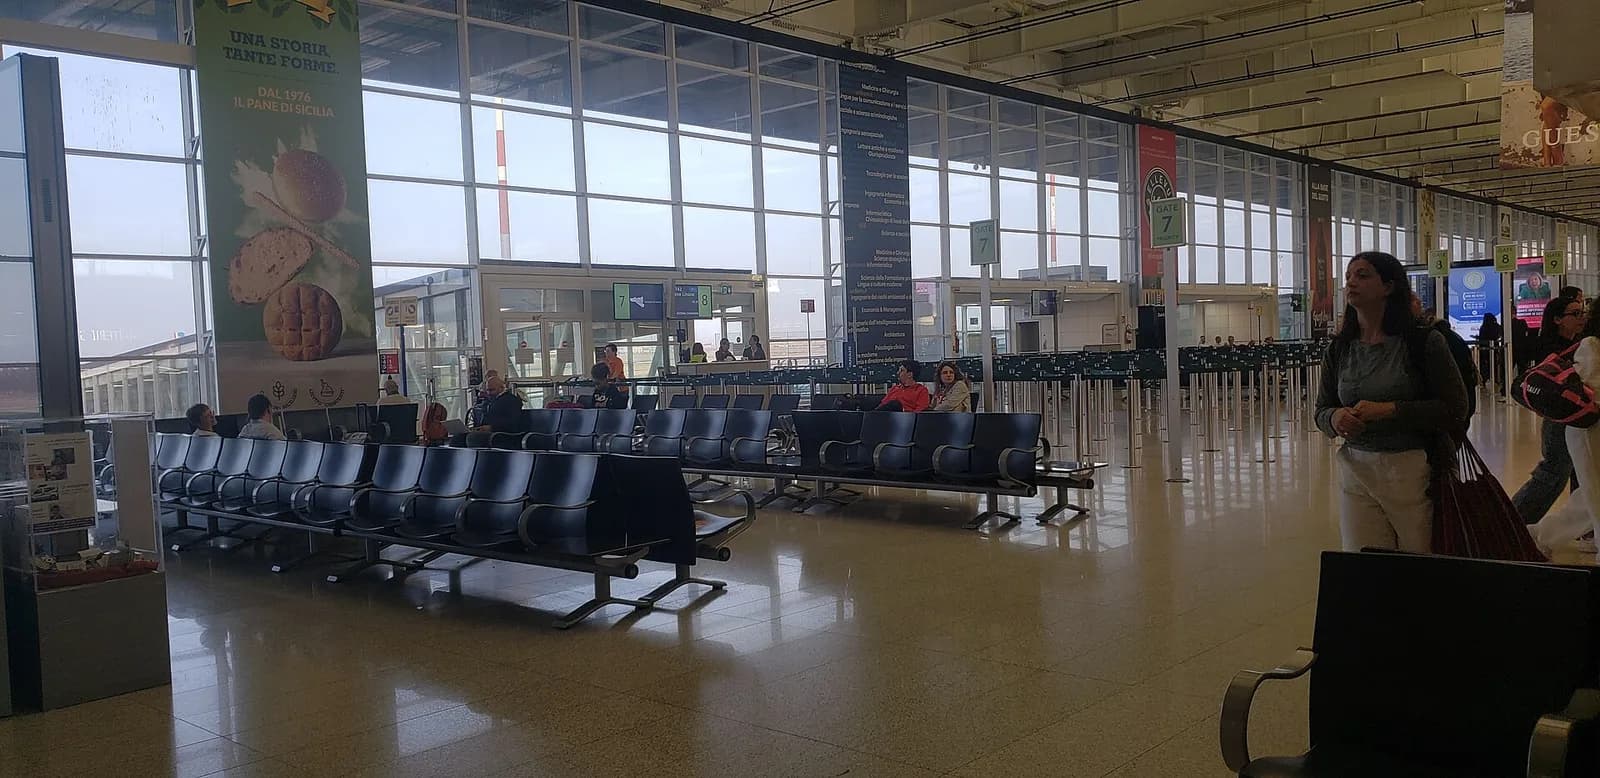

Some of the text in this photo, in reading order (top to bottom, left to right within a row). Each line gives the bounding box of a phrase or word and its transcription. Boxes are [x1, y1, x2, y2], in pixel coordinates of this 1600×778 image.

[229, 30, 266, 47] UNA
[222, 46, 340, 74] TANTE FORME.
[258, 86, 311, 102] DAL 1976
[233, 96, 335, 118] IL PANE DI SICILIA
[1156, 203, 1179, 213] GATE
[975, 224, 993, 234] GATE
[1162, 215, 1173, 233] 7
[979, 237, 988, 254] 7
[1502, 254, 1510, 264] 8
[1550, 260, 1558, 270] 9
[619, 296, 625, 307] 7
[701, 294, 708, 306] 8
